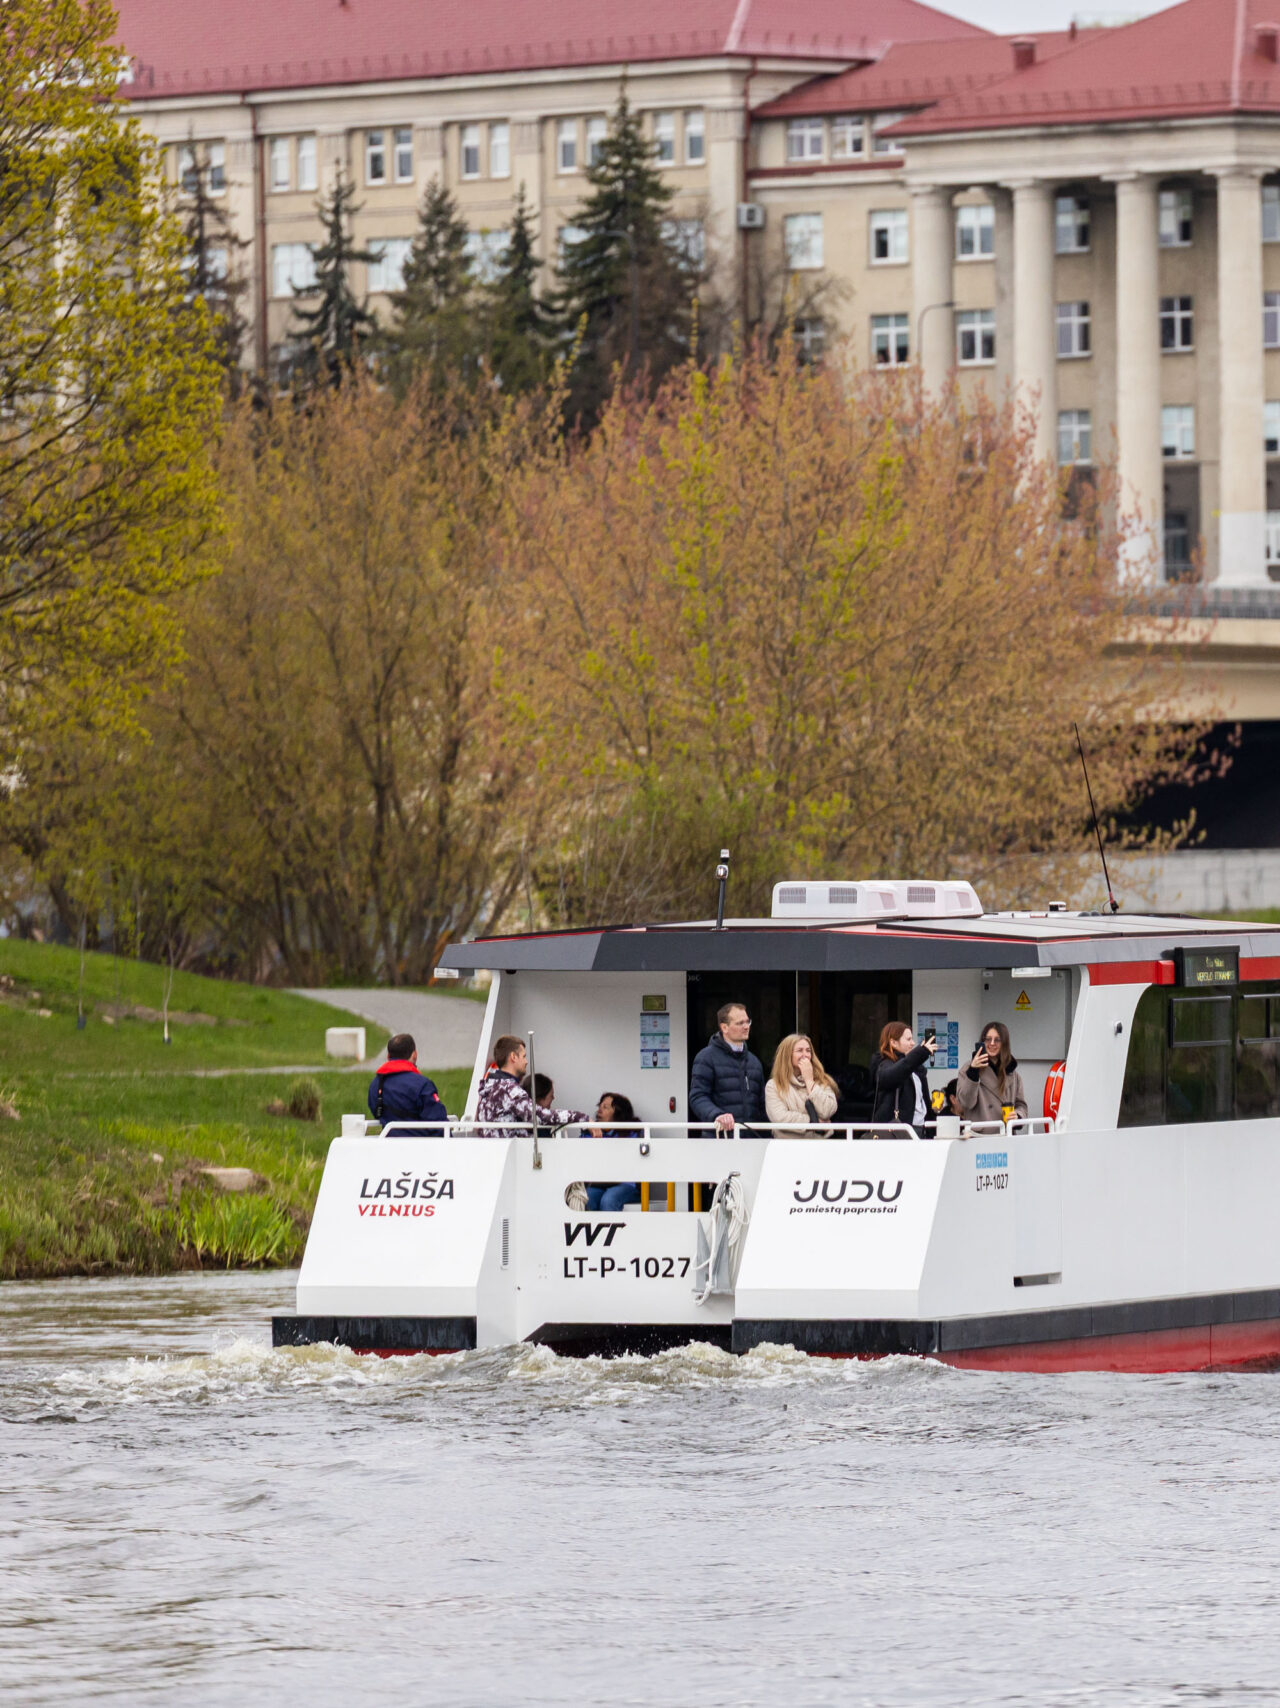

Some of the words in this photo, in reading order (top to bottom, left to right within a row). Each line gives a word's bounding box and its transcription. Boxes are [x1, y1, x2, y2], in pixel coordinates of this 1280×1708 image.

[360, 1171, 455, 1200] LAŠIŠA
[793, 1179, 904, 1203] JUDU
[976, 1173, 1009, 1192] LT-P-1027
[358, 1203, 436, 1217] VILNIUS
[789, 1206, 803, 1215] po
[805, 1205, 841, 1215] miestą
[843, 1205, 898, 1215] paprastai
[564, 1222, 627, 1246] VVT
[563, 1256, 691, 1278] LT-P-1027
